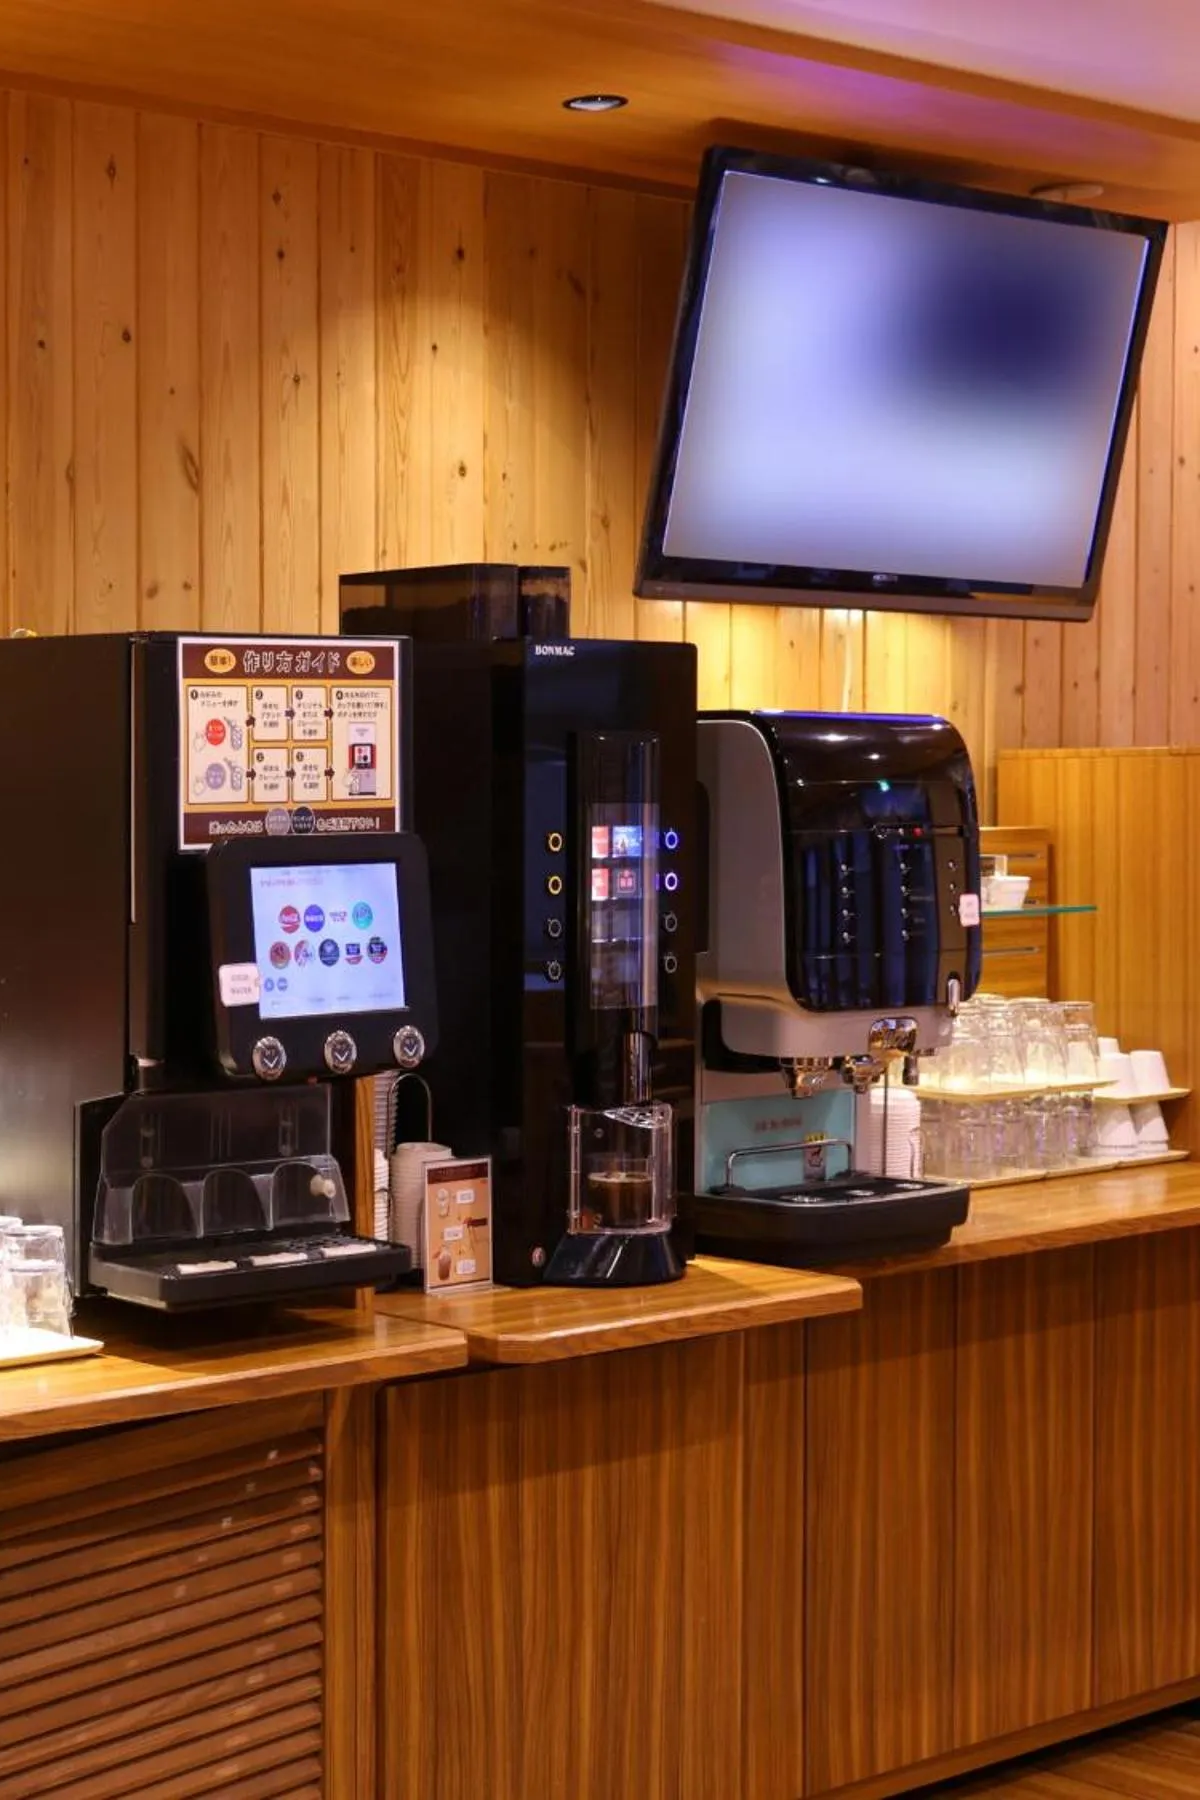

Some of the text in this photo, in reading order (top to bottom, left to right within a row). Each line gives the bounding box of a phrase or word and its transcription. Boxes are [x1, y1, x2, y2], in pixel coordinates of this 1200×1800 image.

[535, 645, 575, 656] BONMAC
[243, 650, 341, 673] 作り方ガイド
